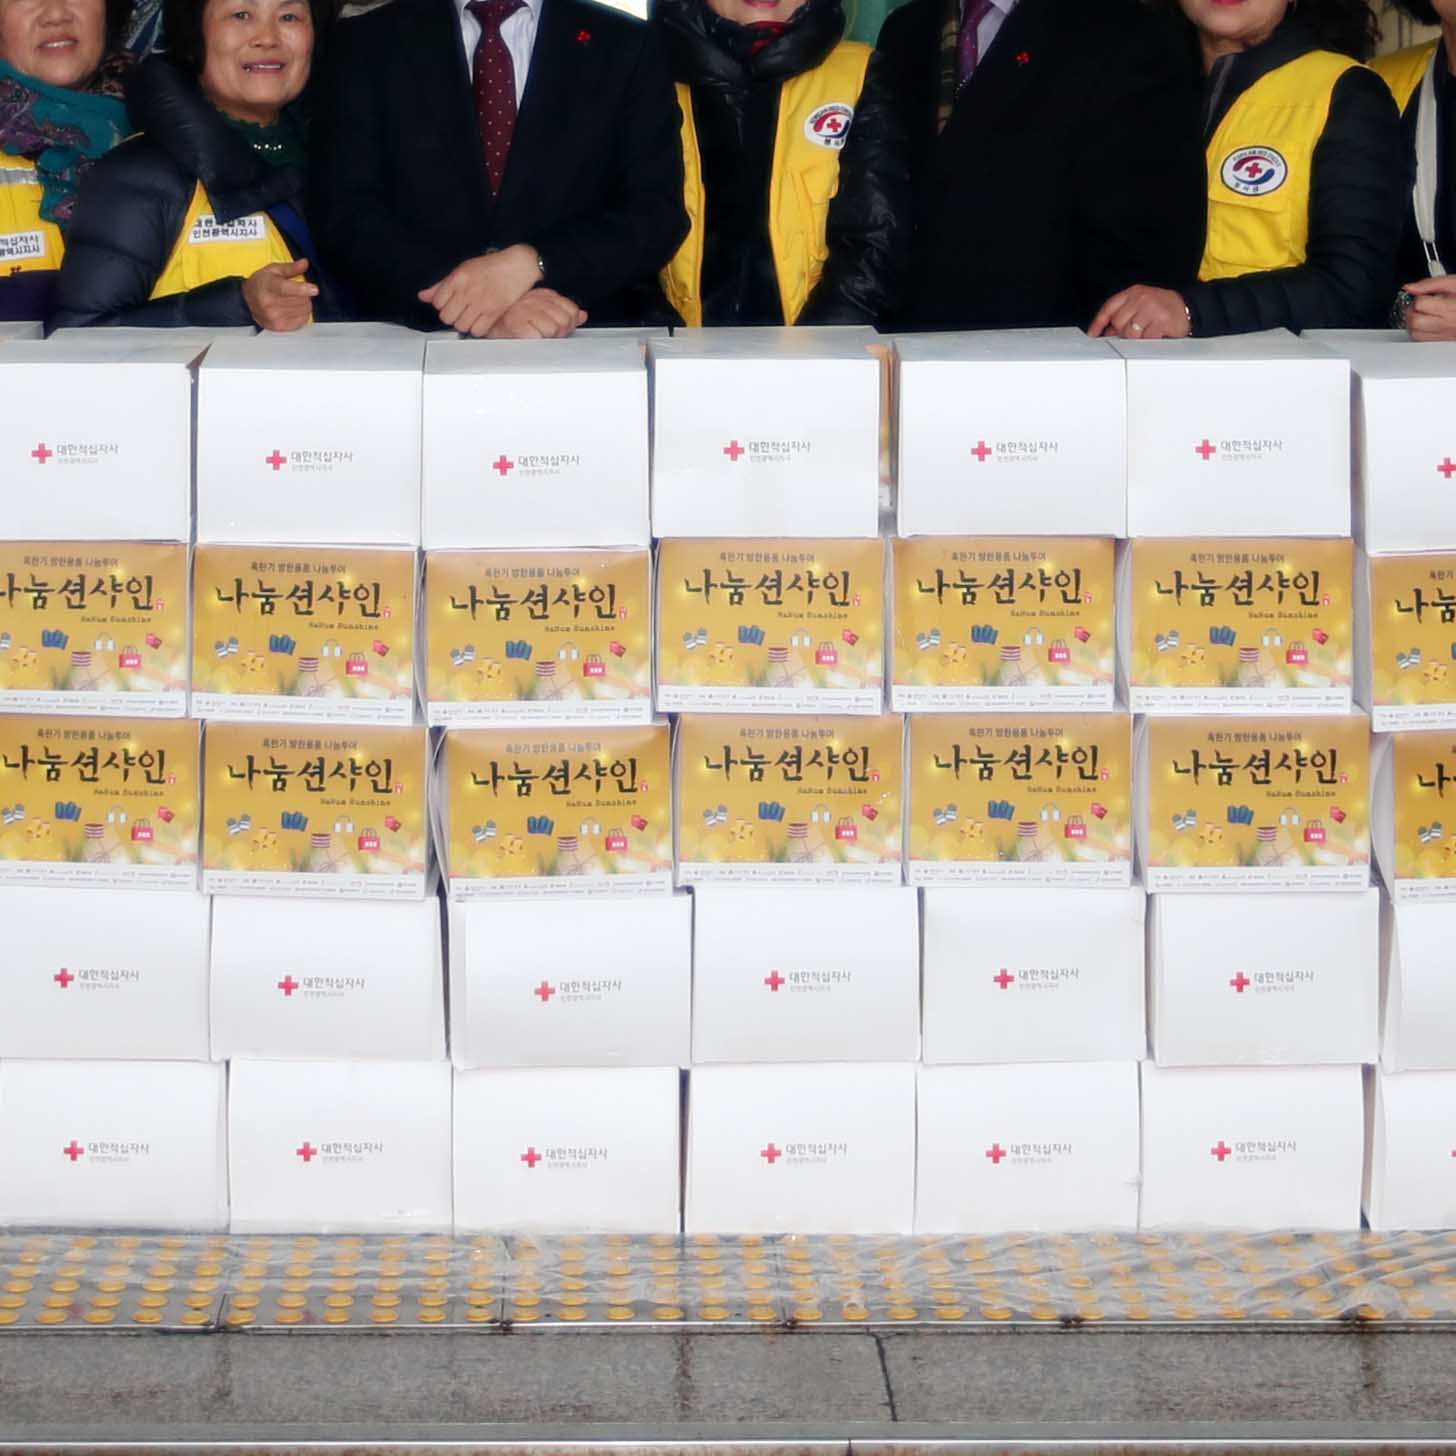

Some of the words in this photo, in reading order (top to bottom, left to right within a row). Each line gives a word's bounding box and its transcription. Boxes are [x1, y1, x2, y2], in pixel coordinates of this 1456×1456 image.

[194, 227, 256, 240] 인천광역시지사
[56, 443, 119, 455] 대한적십자사
[748, 440, 811, 453] 대한적십자사
[996, 441, 1058, 453] 대한적십자사
[1220, 439, 1282, 452] 대한적십자사
[291, 450, 353, 463] 대한적십자사
[518, 454, 580, 467] 대한적십자사
[684, 568, 850, 606] 나눔션샤인
[917, 568, 1081, 606] 나눔션샤인
[1155, 569, 1320, 607] 나눔션샤인
[216, 578, 380, 618] 나눔션샤인
[450, 583, 616, 622] 나눔션샤인
[2, 744, 165, 784] 나눔션샤인
[704, 745, 869, 782] 나눔션샤인
[934, 744, 1098, 781] 나눔션샤인
[1173, 748, 1337, 786] 나눔션샤인
[227, 754, 392, 794] 나눔션샤인
[471, 758, 638, 797] 나눔션샤인
[78, 968, 140, 982] 대한적십자사
[789, 970, 851, 983] 대한적십자사
[1018, 968, 1079, 981] 대한적십자사
[1254, 970, 1314, 984] 대한적십자사
[302, 976, 365, 990] 대한적십자사
[559, 980, 622, 993] 대한적십자사
[88, 1141, 149, 1155] 대한적십자사
[321, 1142, 383, 1154] 대한적십자사
[785, 1142, 847, 1155] 대한적십자사
[1010, 1143, 1072, 1155] 대한적십자사
[1235, 1140, 1296, 1153] 대한적십자사
[545, 1147, 608, 1160] 대한적십자사
